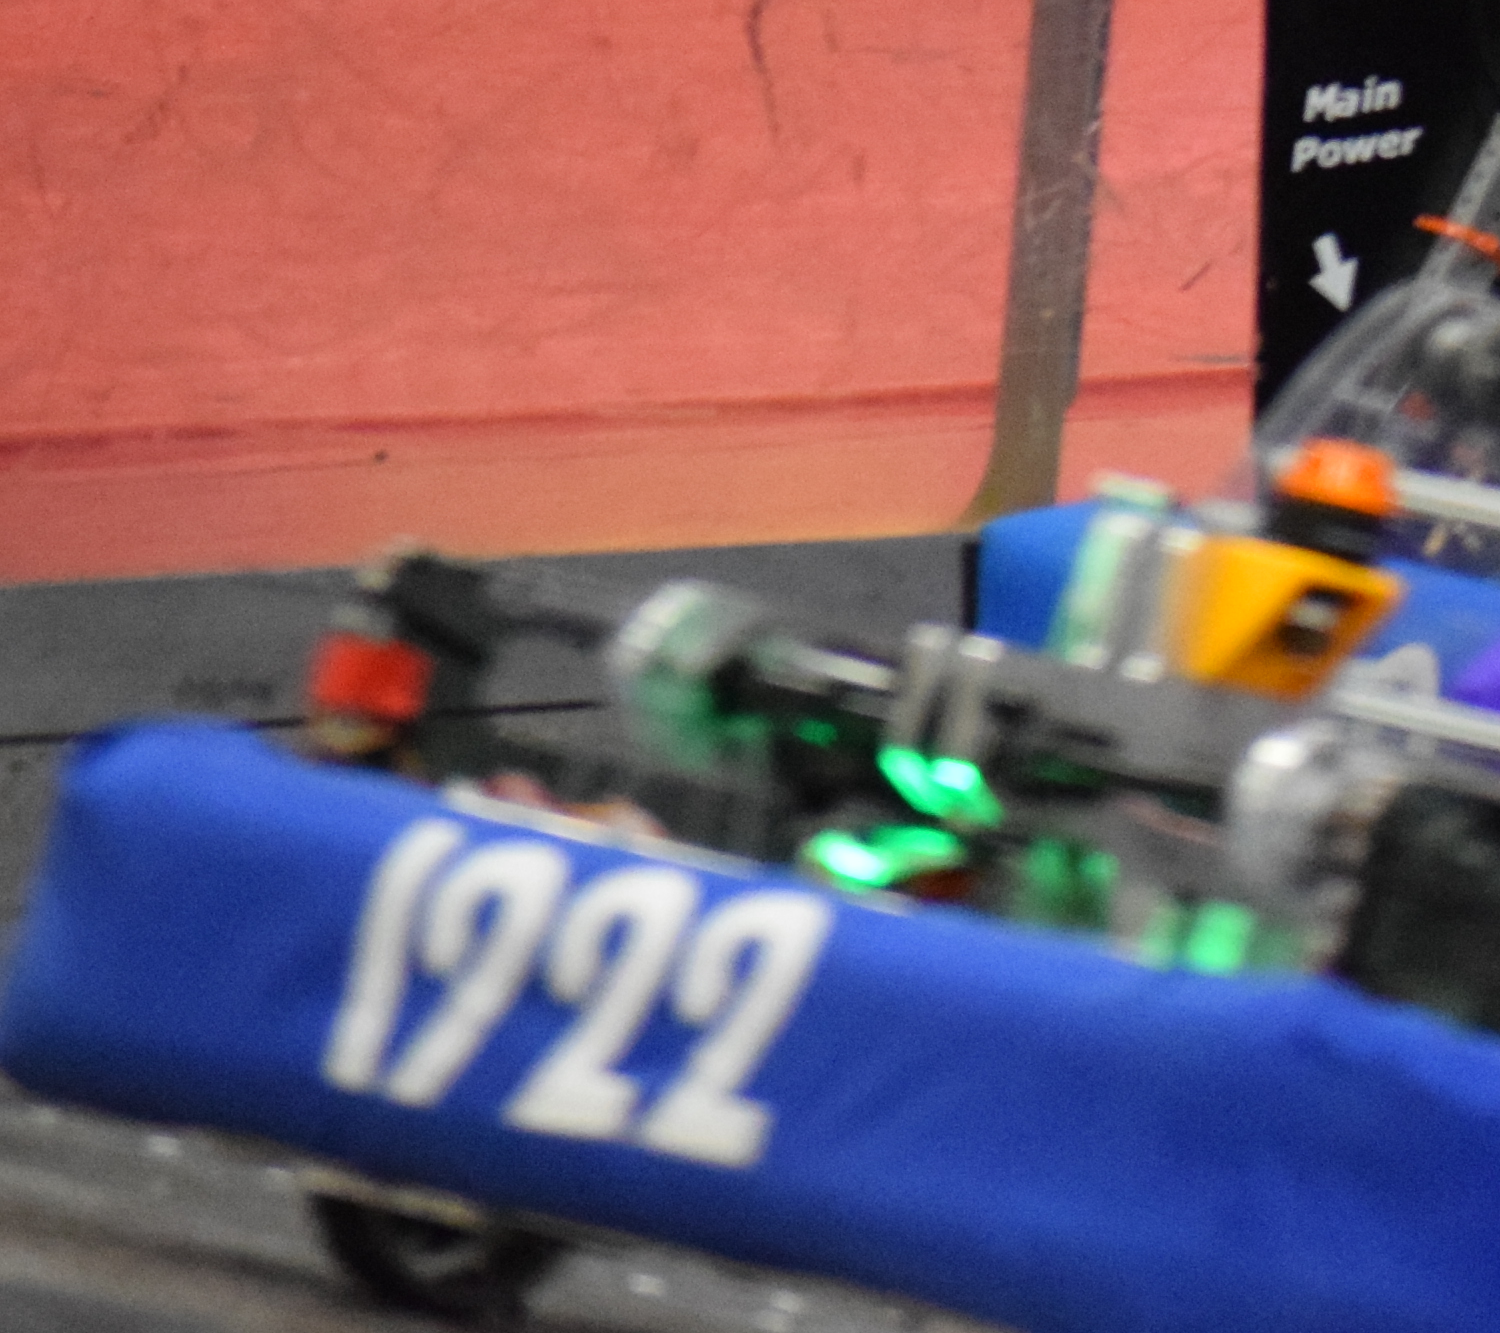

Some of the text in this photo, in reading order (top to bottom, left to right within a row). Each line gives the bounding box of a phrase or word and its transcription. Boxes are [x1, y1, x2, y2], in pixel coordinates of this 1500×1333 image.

[1302, 74, 1402, 124] Main
[1289, 126, 1424, 174] Power
[320, 819, 832, 1169] 1922
